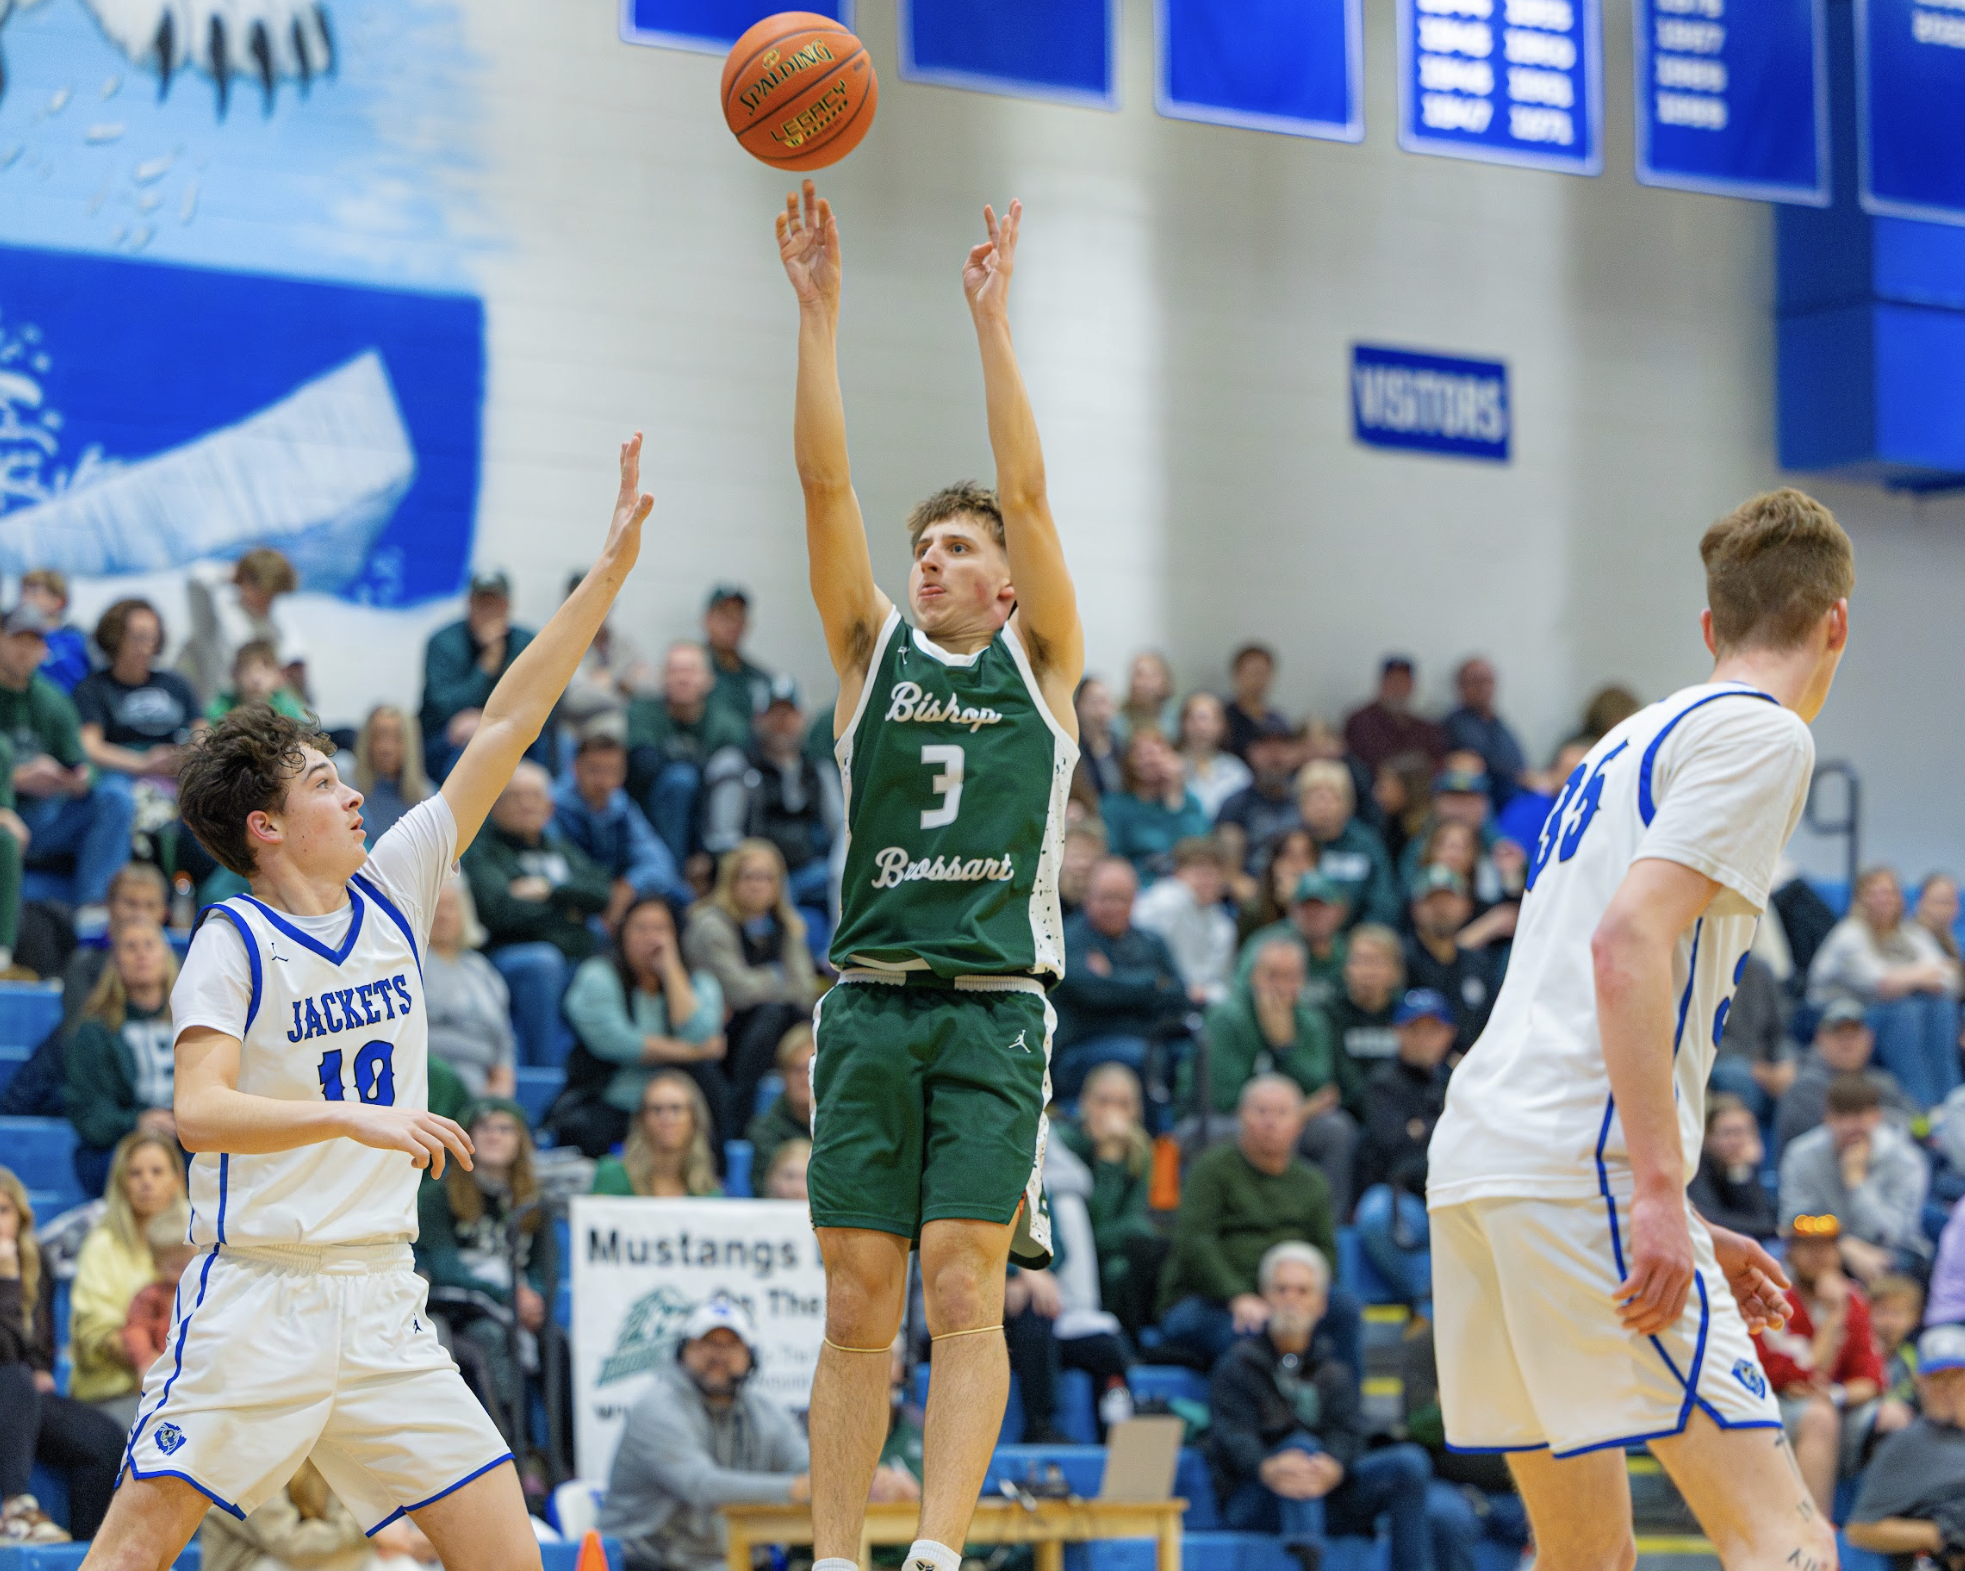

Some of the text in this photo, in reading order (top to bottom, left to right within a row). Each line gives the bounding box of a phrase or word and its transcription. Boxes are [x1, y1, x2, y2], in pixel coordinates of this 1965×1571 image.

[739, 39, 835, 116] SPALDING
[770, 79, 846, 142] LEGACY
[1355, 368, 1502, 440] VISITORS
[885, 681, 1002, 733] Bishop
[920, 744, 965, 829] 3
[871, 846, 1014, 889] Brossart
[287, 974, 412, 1043] JACKETS
[317, 1039, 396, 1107] 10
[587, 1227, 799, 1276] Mustangs
[766, 1288, 820, 1317] The
